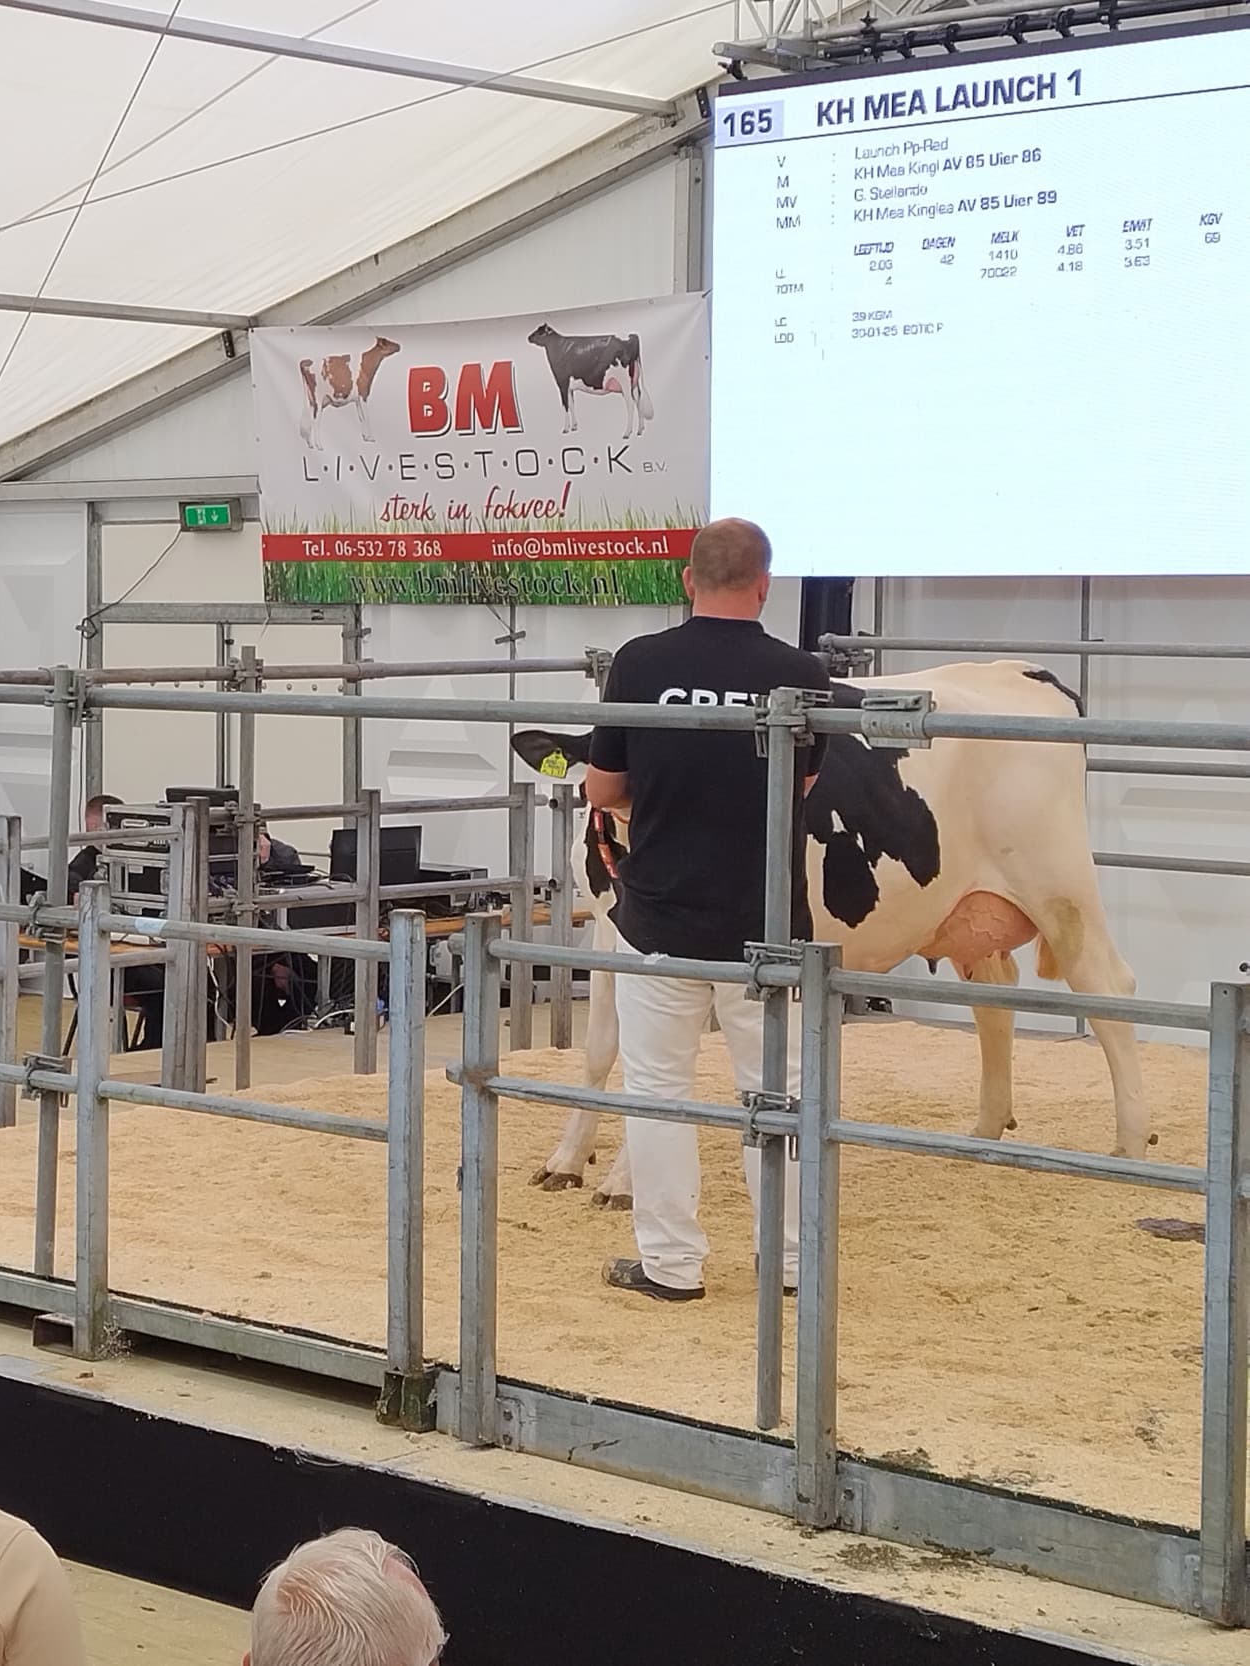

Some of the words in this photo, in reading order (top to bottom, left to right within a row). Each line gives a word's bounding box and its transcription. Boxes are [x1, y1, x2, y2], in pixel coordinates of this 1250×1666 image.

[723, 107, 773, 137] 165
[816, 97, 855, 127] KH
[864, 89, 928, 122] MEA
[935, 72, 1057, 113] LAUNCH
[1066, 69, 1082, 97] 1
[777, 155, 786, 168] V
[854, 144, 900, 160] Launch
[903, 138, 949, 157] Pp-Red
[776, 176, 790, 189] M
[853, 166, 875, 180] KH
[876, 163, 906, 178] Mea
[942, 157, 962, 172] AV
[965, 154, 985, 169] 85
[989, 151, 1019, 167] Uier
[1022, 148, 1042, 163] 86
[776, 196, 798, 209] MV
[853, 188, 867, 202] G.
[776, 216, 801, 229] MM
[853, 208, 874, 222] KH
[876, 204, 906, 220] Mea
[957, 199, 977, 213] AV
[980, 195, 1000, 210] 85
[1003, 191, 1034, 208] Uier
[1037, 190, 1058, 205] 89
[1065, 224, 1086, 238] VET
[1198, 212, 1223, 226] KGV
[407, 359, 525, 438] BM
[380, 491, 437, 523] sterk
[447, 499, 473, 522] in
[484, 480, 572, 521] fokvee!
[301, 539, 332, 558] Tel.
[334, 539, 385, 558] 06-532
[387, 539, 407, 558] 78
[412, 539, 443, 558] 368
[491, 535, 670, 559] info@bmlivestock.nl
[350, 568, 624, 598] www.bmlivestock.nl
[658, 687, 771, 707] CRE
